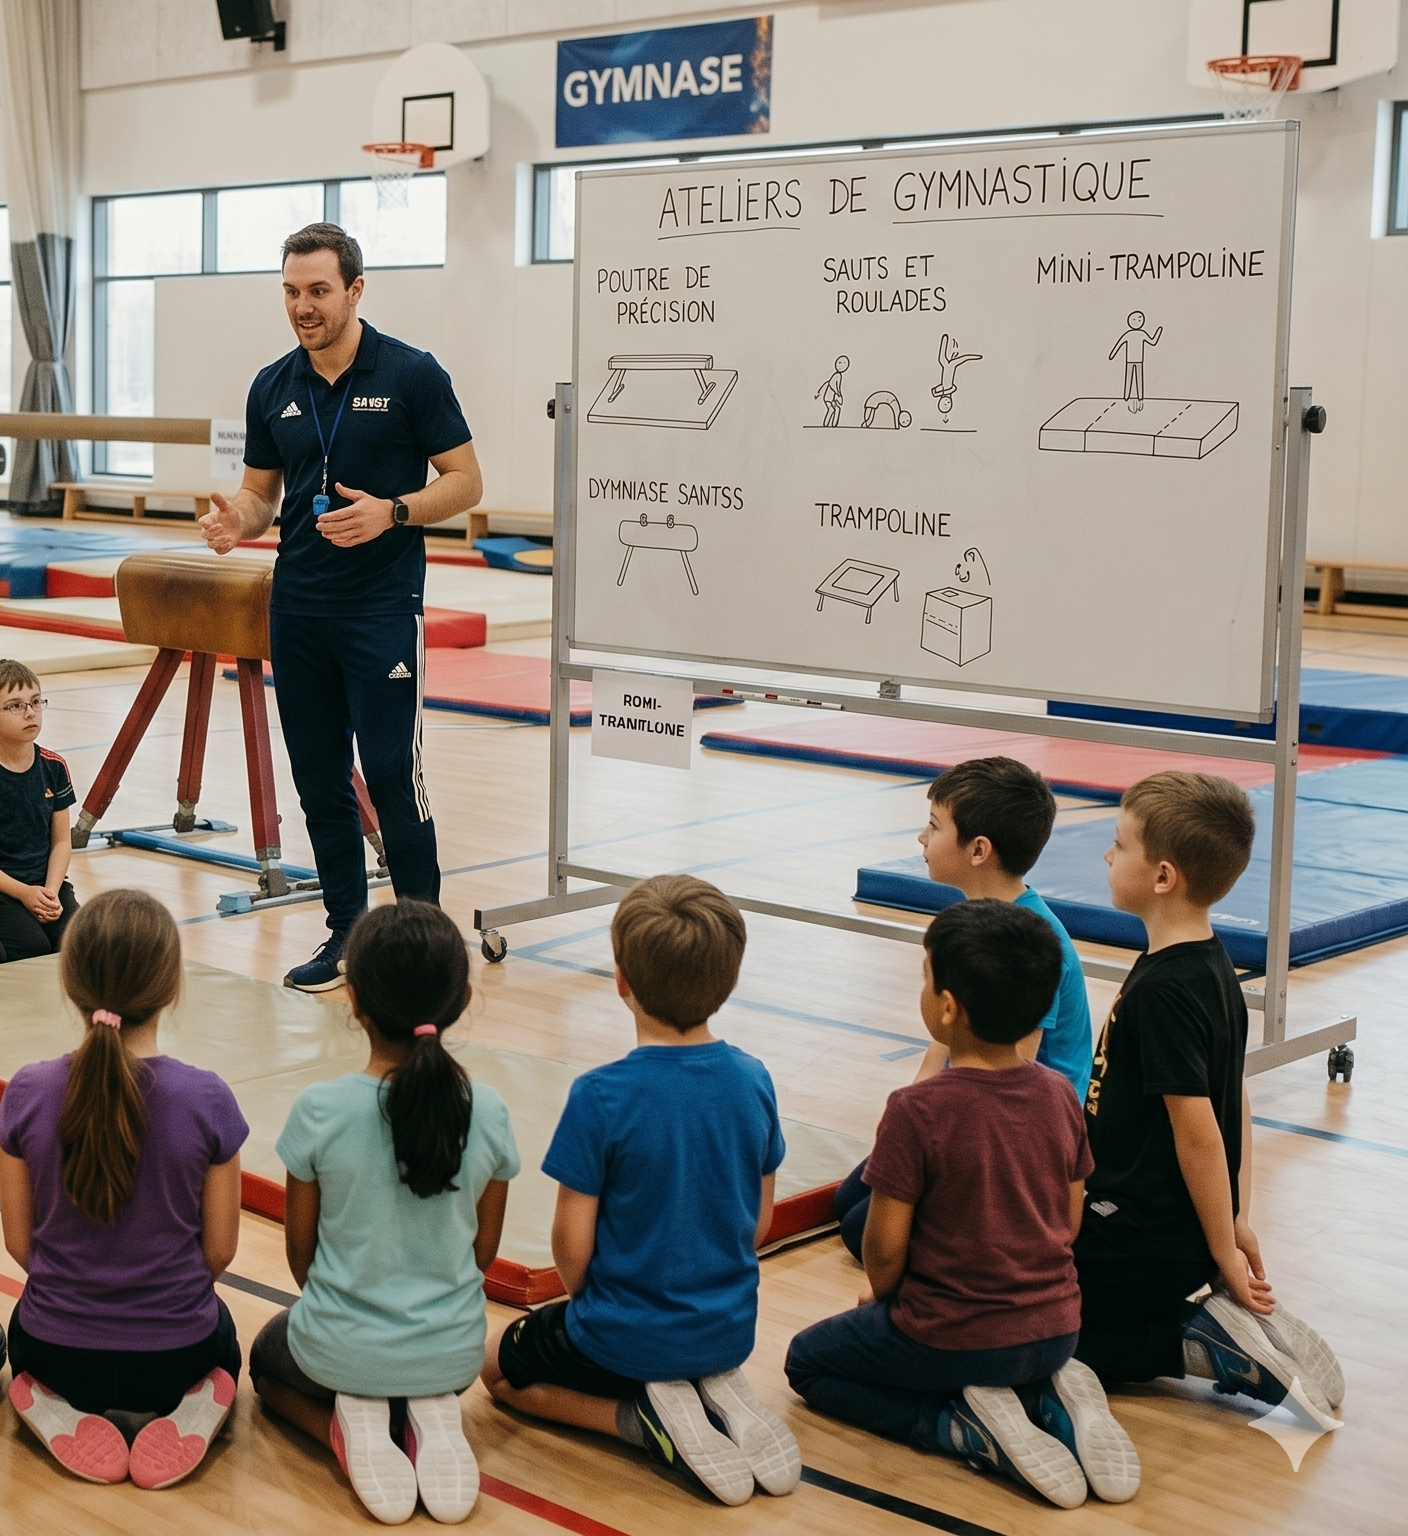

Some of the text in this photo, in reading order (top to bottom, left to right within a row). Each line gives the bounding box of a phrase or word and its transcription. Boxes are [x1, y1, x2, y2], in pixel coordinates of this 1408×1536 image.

[563, 54, 743, 108] GYMNASE
[658, 157, 1151, 229] ATELIERS DE GYMNASTIQUE
[597, 265, 711, 294] POUTRE DE
[823, 254, 935, 283] SAUTS ET
[617, 296, 715, 325] PRÉCISION
[836, 286, 947, 314] ROULADES
[588, 477, 744, 511] DYMNIASE SANTSS
[814, 502, 951, 538] TRAMPOLINE
[623, 693, 662, 711] ROMI-
